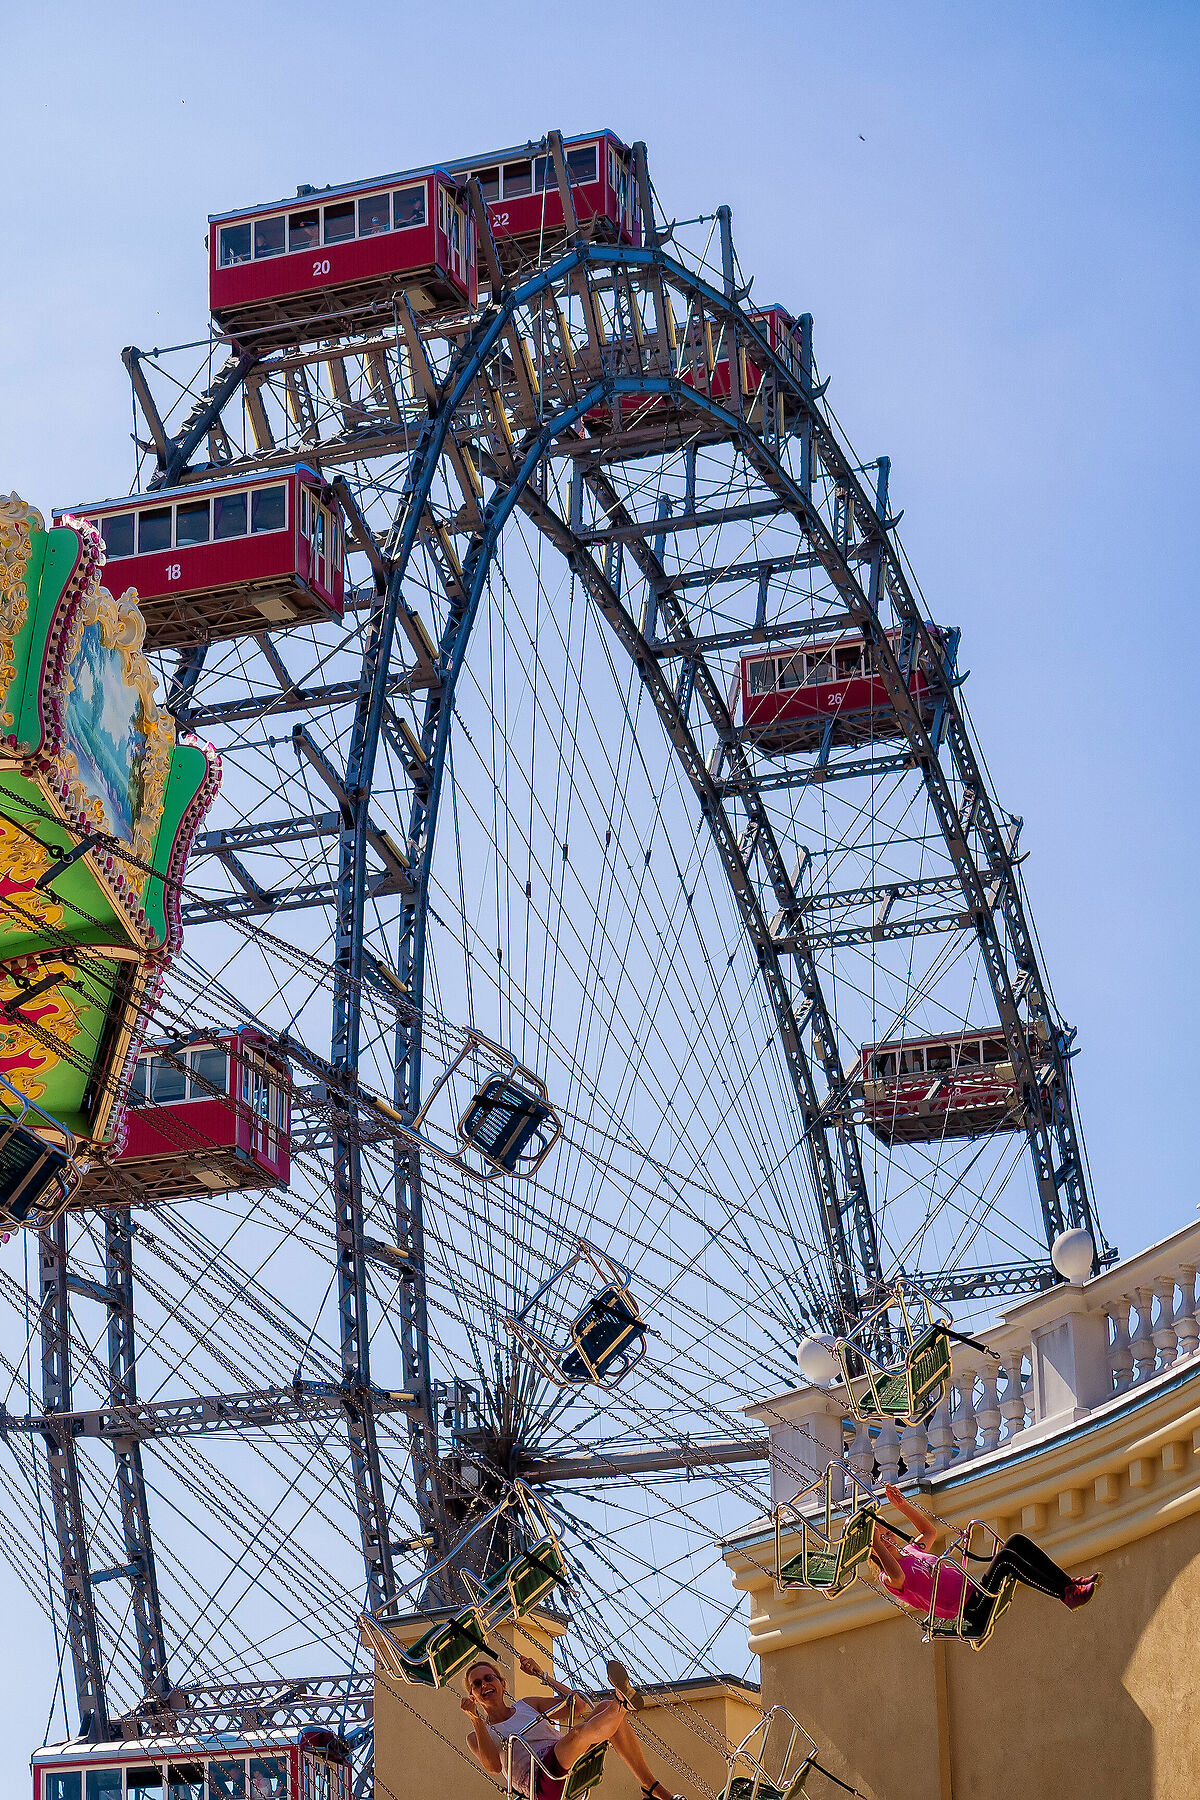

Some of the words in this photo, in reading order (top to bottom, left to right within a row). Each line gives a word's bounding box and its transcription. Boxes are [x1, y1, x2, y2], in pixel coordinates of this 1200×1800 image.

[492, 212, 510, 228] 22
[312, 259, 330, 276] 20
[165, 563, 182, 581] 18
[827, 692, 842, 706] 26
